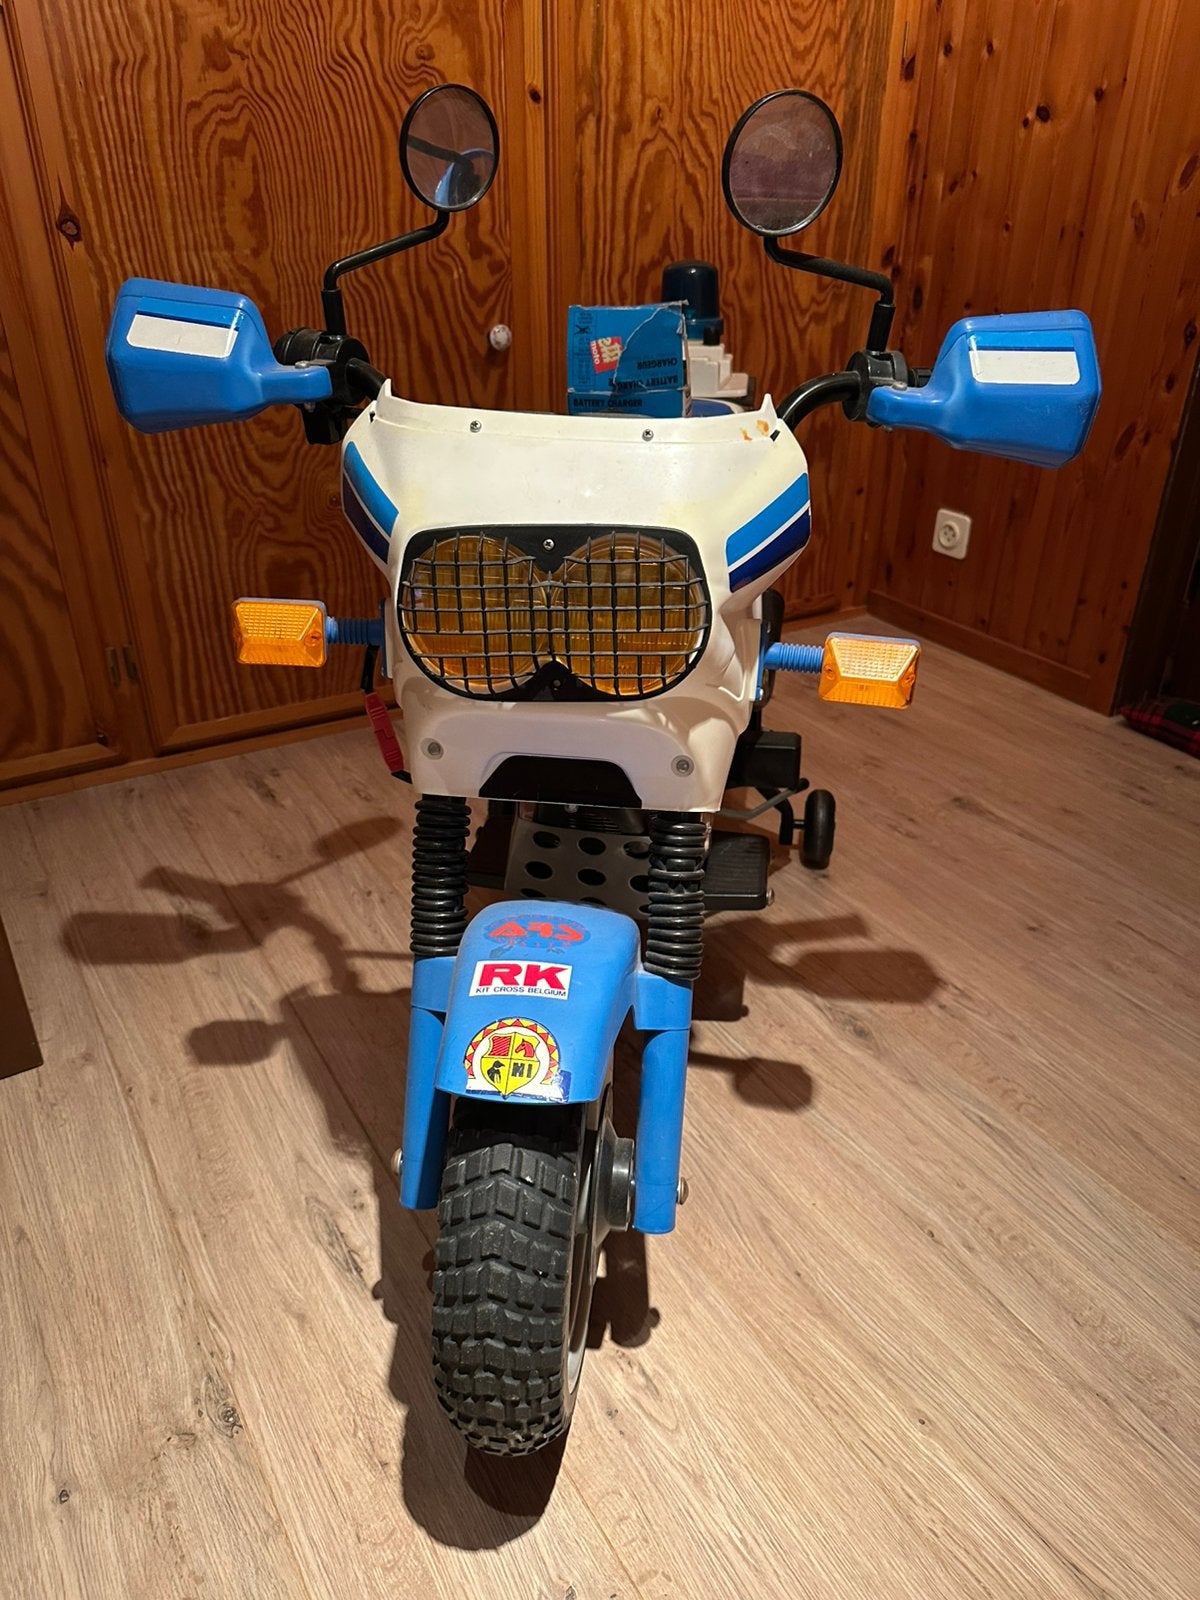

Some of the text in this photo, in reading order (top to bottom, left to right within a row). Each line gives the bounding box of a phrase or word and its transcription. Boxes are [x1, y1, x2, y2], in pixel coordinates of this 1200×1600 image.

[590, 340, 601, 365] moto
[637, 358, 677, 370] CHARGEUR
[479, 963, 568, 991] RK
[475, 986, 489, 994] KIT
[527, 987, 567, 997] BELGIUM
